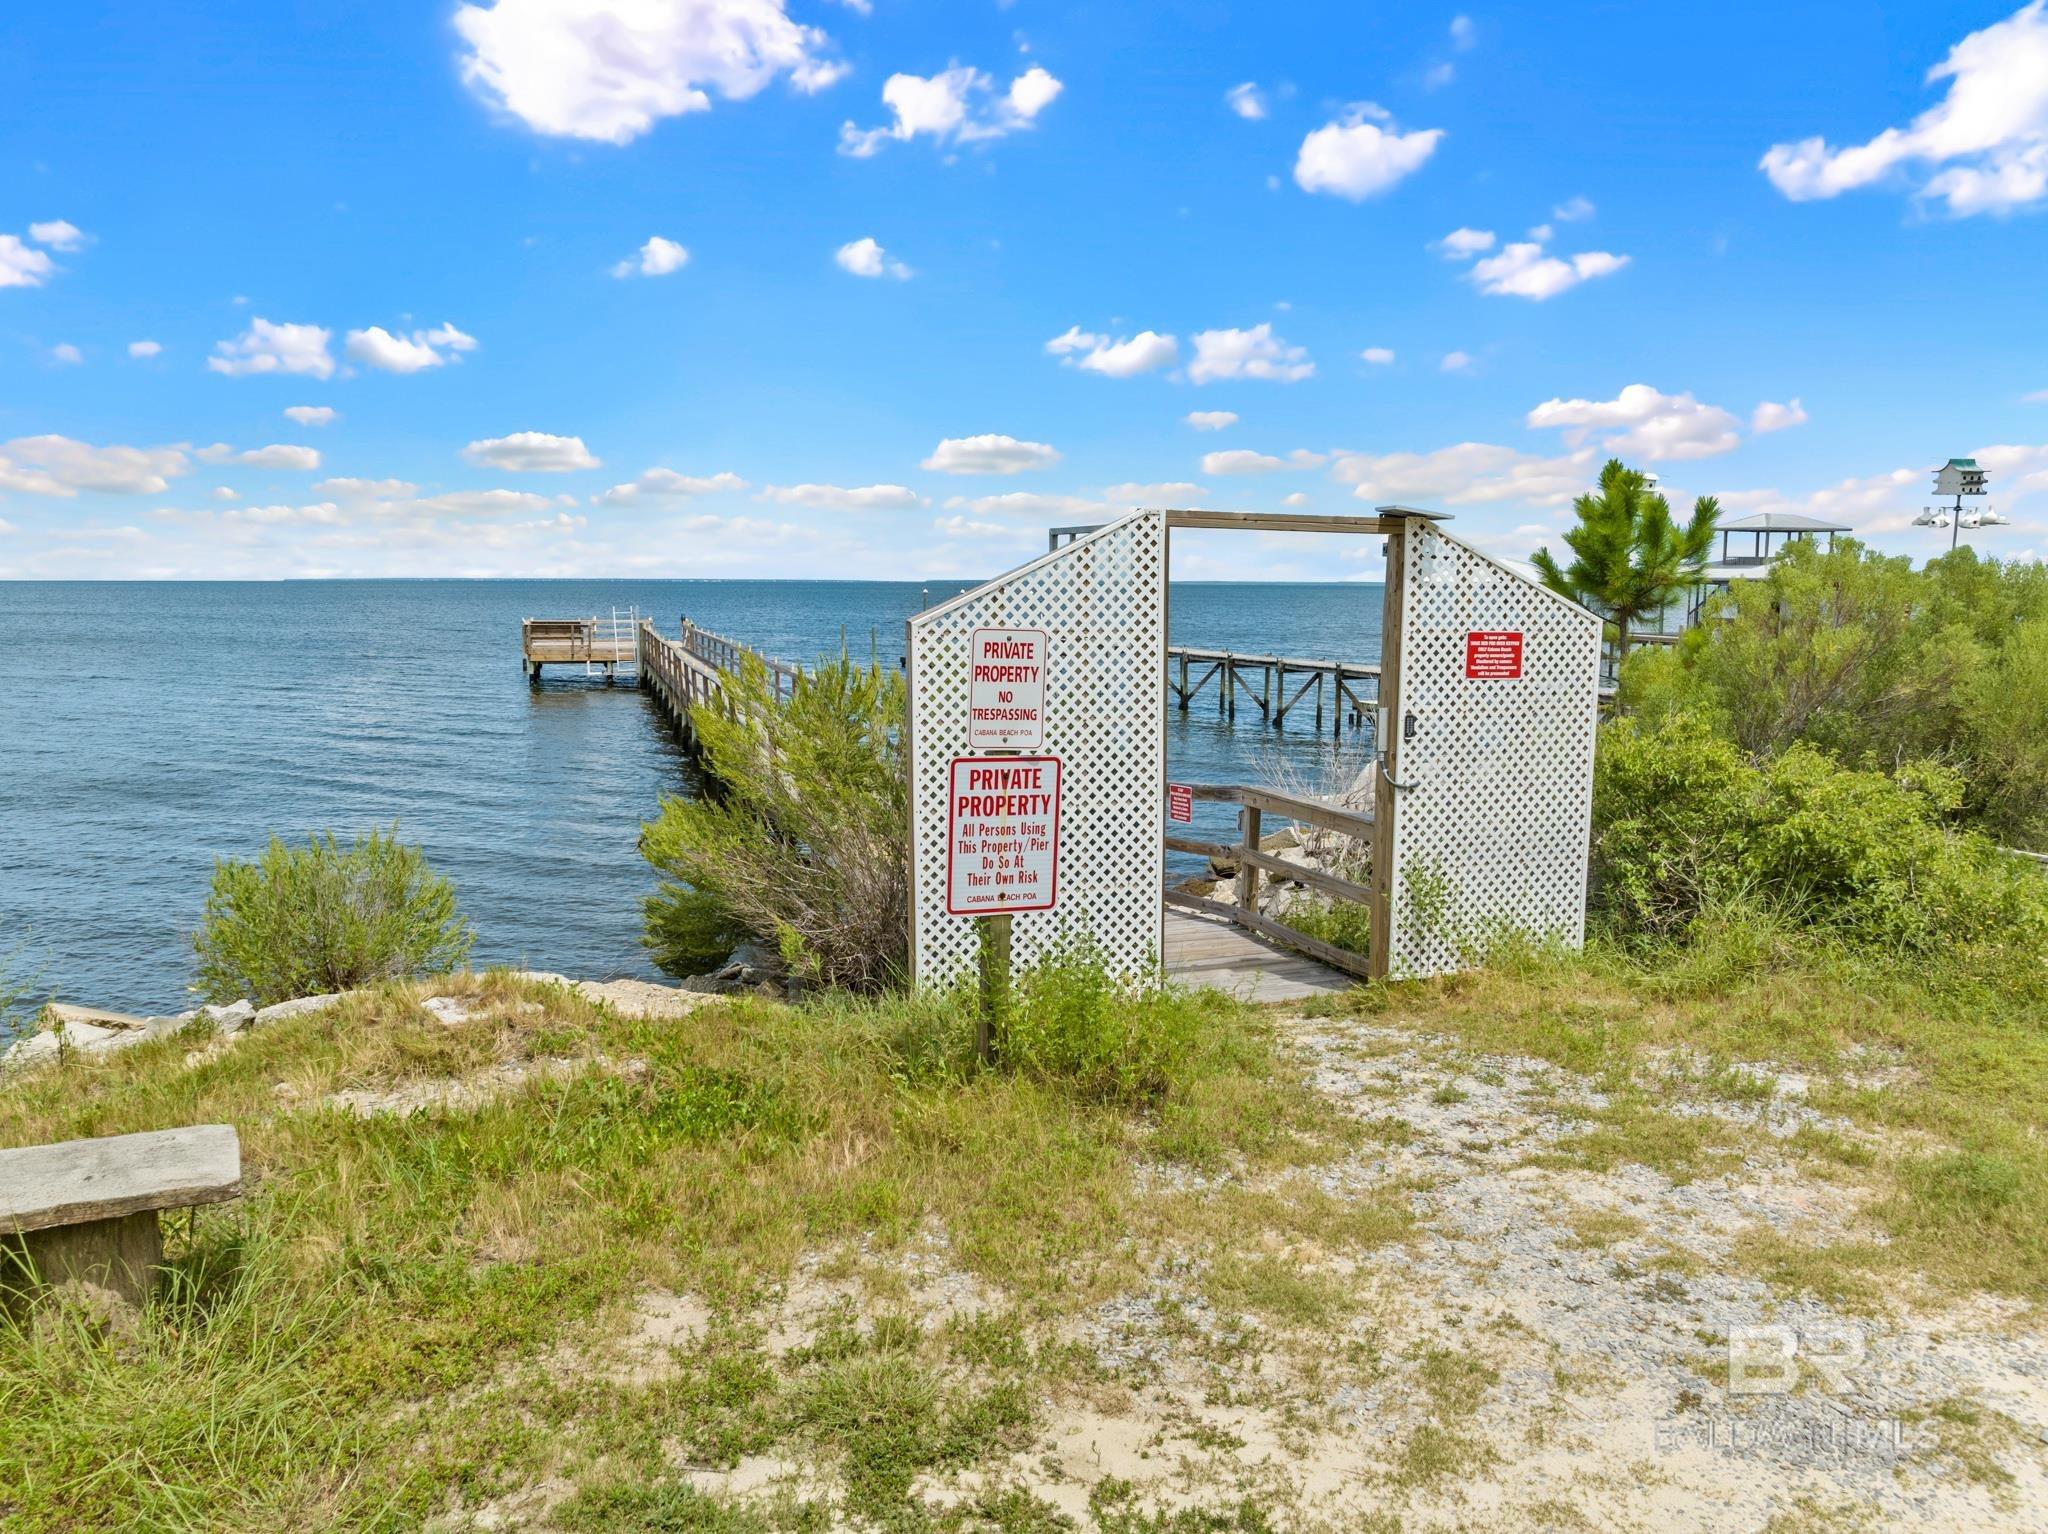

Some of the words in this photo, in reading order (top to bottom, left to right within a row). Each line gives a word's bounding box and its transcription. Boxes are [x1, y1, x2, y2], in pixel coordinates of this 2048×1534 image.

[983, 642, 1034, 660] PRIVATE
[974, 665, 1039, 683] PROPERTY
[998, 691, 1013, 703] NO
[972, 708, 1037, 720] TRESPASSING
[969, 768, 1042, 790] PRIVATE
[958, 794, 1051, 817] PROPERTY
[962, 824, 975, 837] All
[979, 823, 1016, 837] Persons
[1020, 821, 1046, 836] Using
[958, 840, 977, 854] This
[981, 837, 1049, 855] Property/Pier
[982, 857, 994, 869] Do
[998, 856, 1010, 868] So
[1014, 855, 1024, 868] At
[967, 873, 991, 886] Their
[995, 872, 1014, 885] Own
[1018, 870, 1038, 883] Risk
